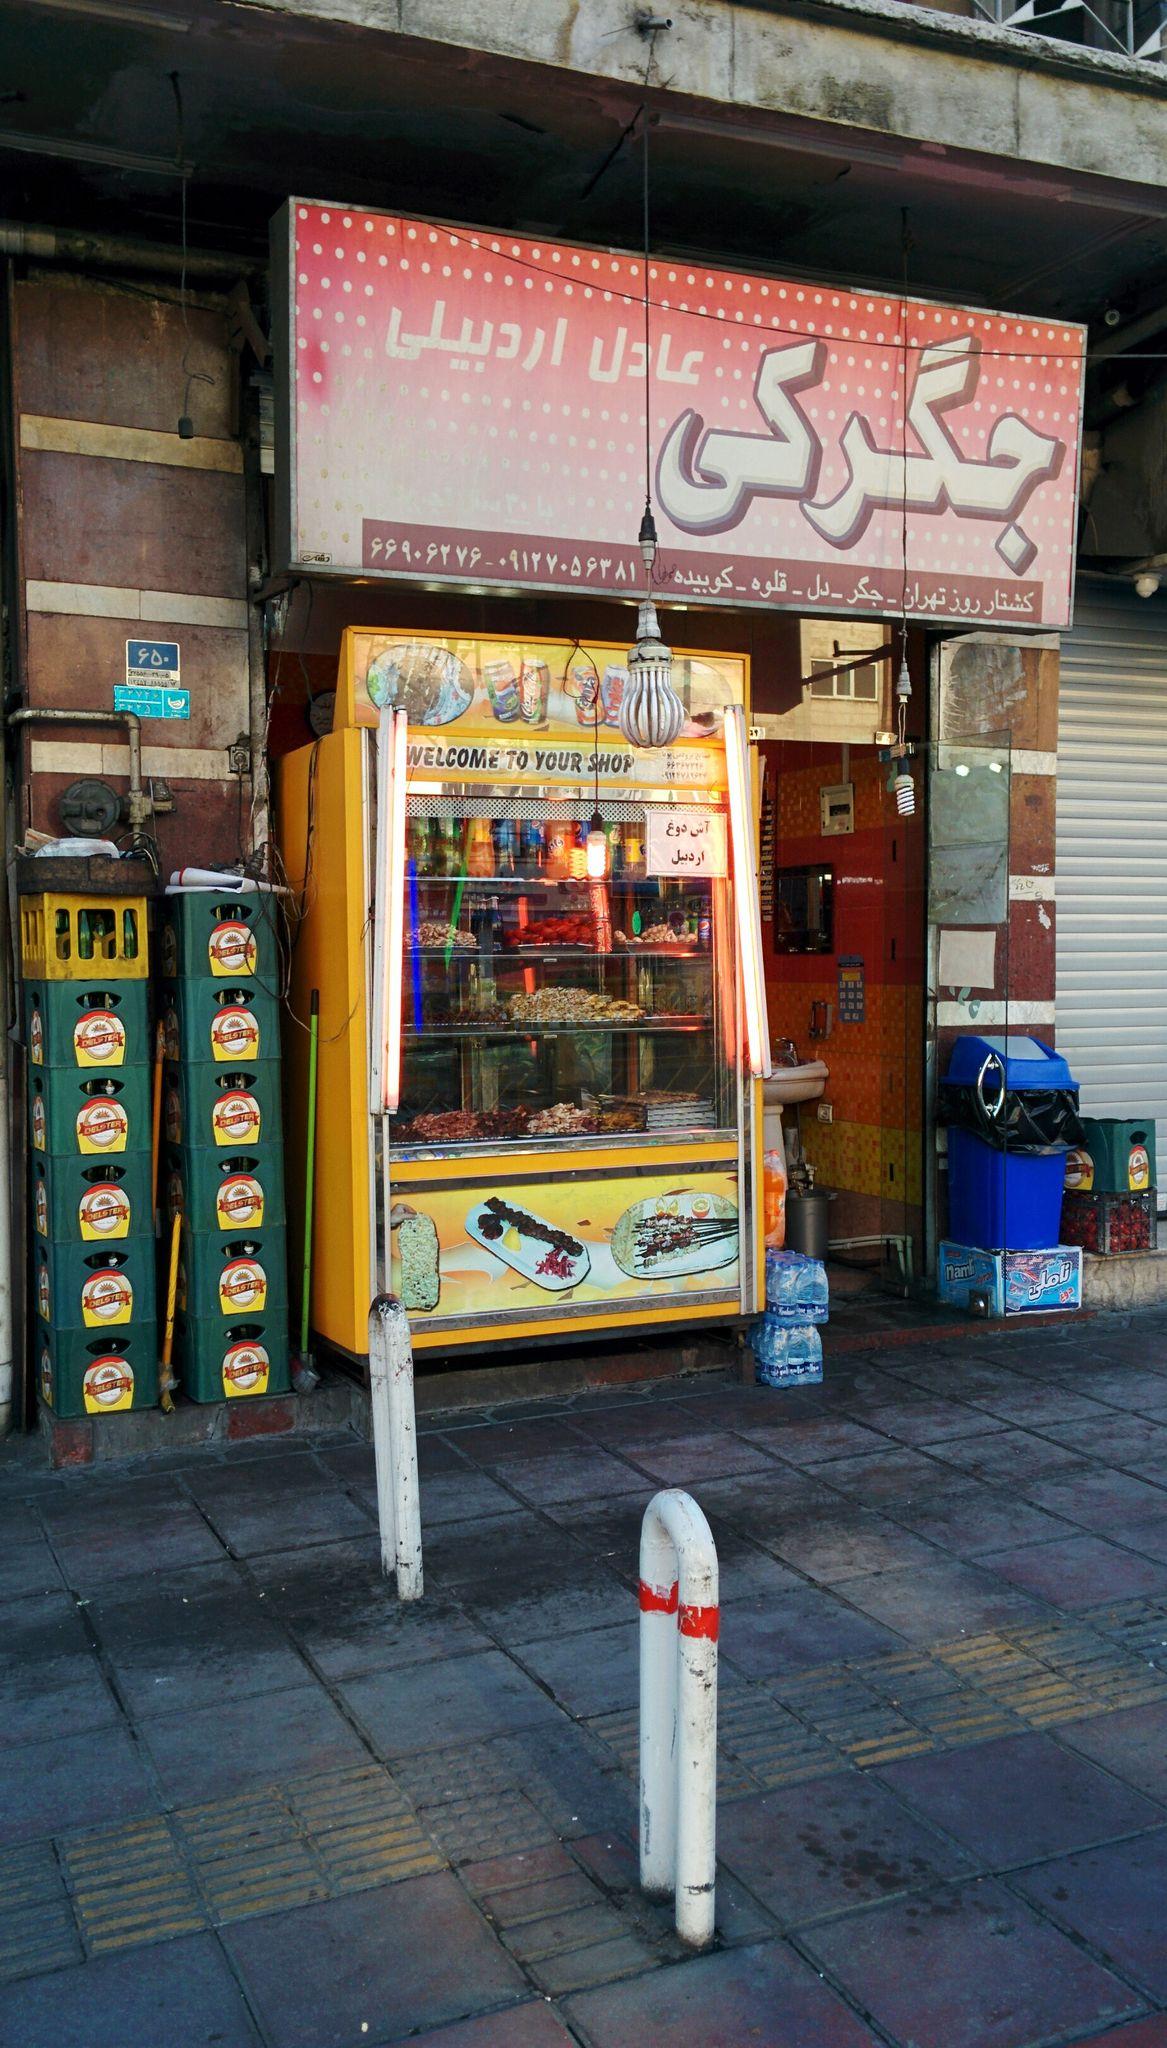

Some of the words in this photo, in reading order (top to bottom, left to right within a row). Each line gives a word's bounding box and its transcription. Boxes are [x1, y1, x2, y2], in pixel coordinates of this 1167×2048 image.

[385, 300, 568, 373] اردبیلی
[588, 326, 705, 386] عادل
[656, 332, 1066, 577] جگرکی
[371, 537, 482, 568] ۶۶۹۰۶۲۷۶
[499, 549, 636, 583] ۰۹۱۲۷۰۵۶۳۸۱
[674, 566, 734, 596] کوبیده
[752, 569, 787, 599] قلوه
[807, 574, 831, 599] دل
[846, 577, 883, 606] جگر
[904, 584, 946, 611] تهران
[949, 594, 981, 616] روز
[984, 590, 1034, 616] کشتار
[138, 648, 170, 666] ۶۵۰
[406, 747, 500, 769] WELCOME
[506, 750, 529, 770] TO
[535, 751, 583, 773] YOUR
[587, 753, 635, 774] SHOP
[665, 819, 687, 837] دوغ
[690, 820, 710, 837] آش
[671, 849, 705, 866] اردبیل
